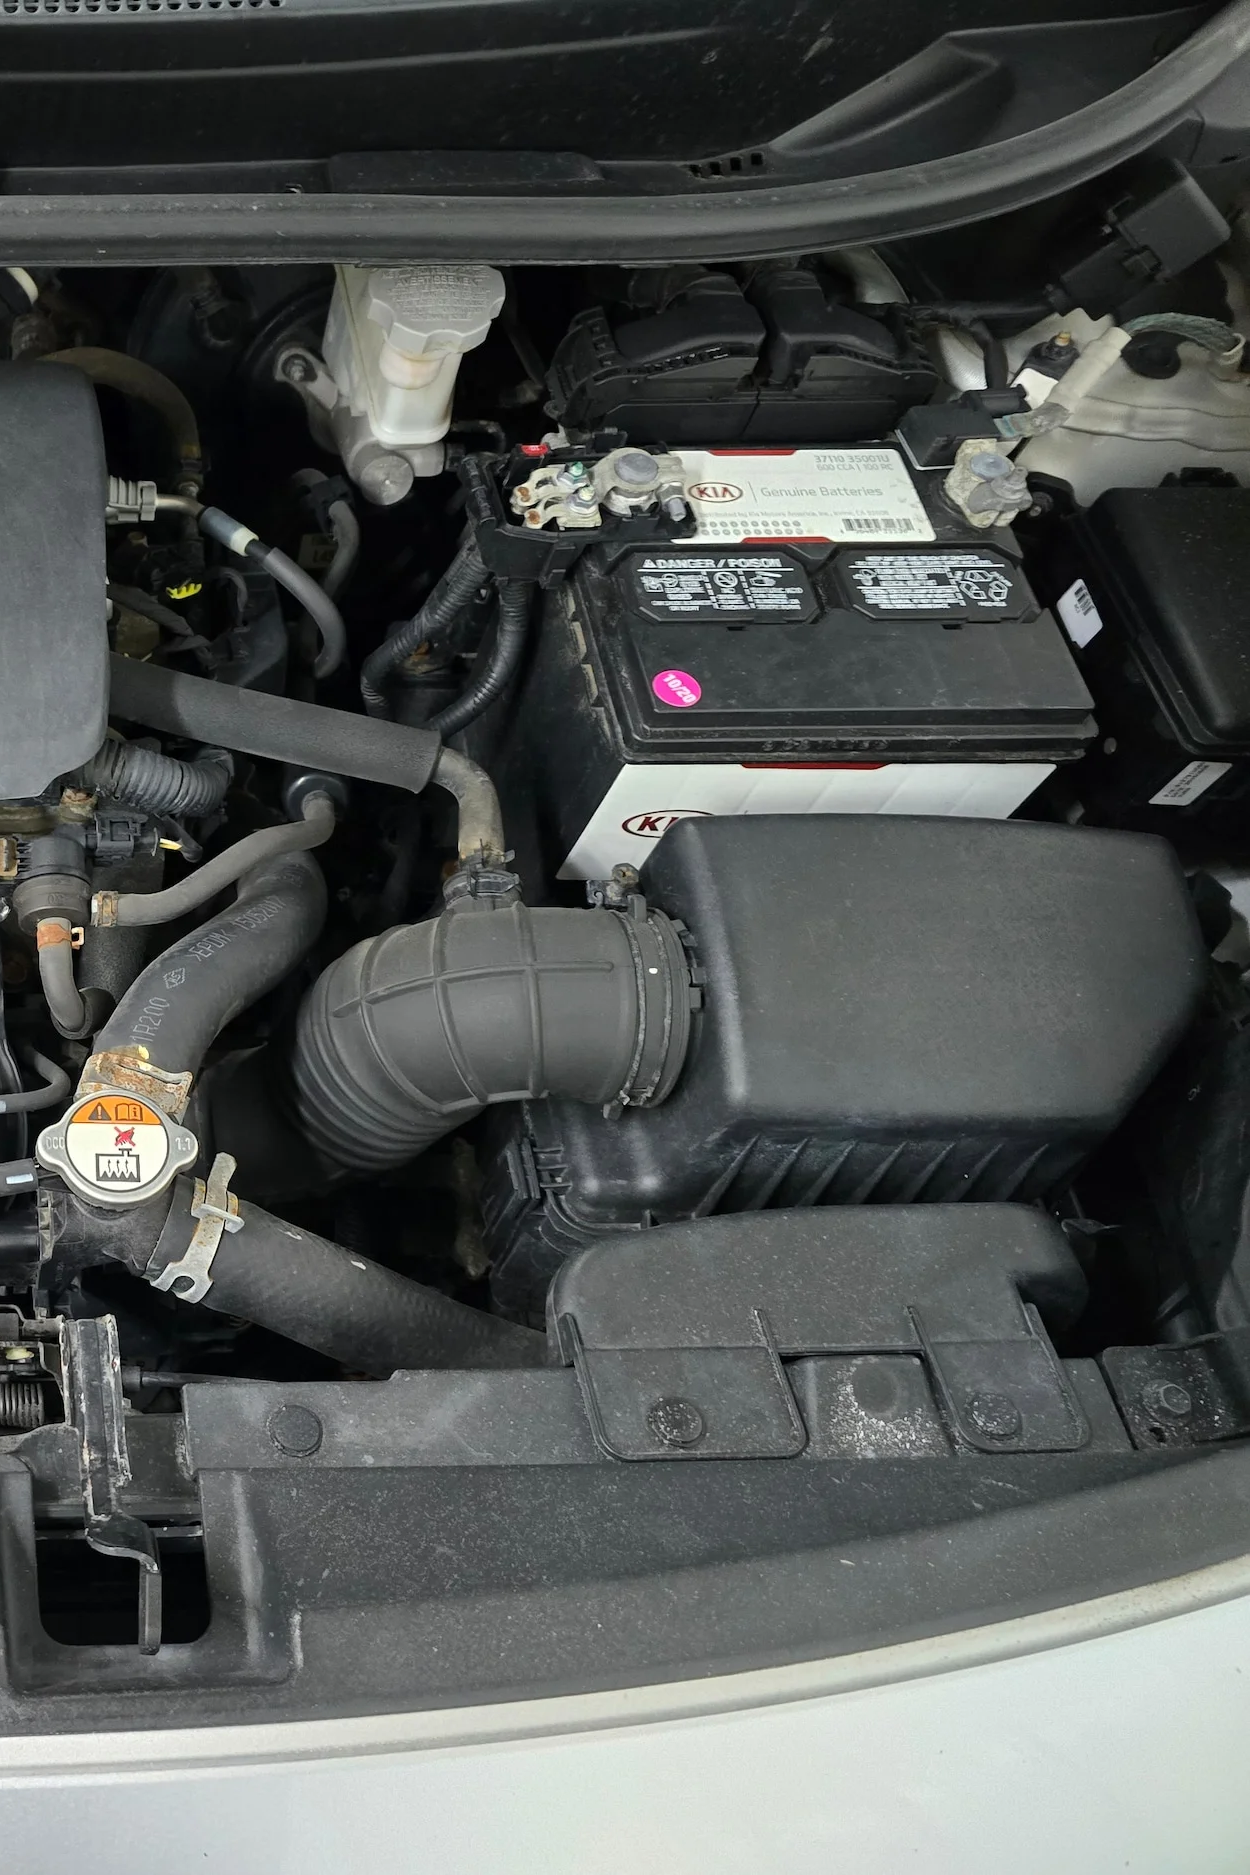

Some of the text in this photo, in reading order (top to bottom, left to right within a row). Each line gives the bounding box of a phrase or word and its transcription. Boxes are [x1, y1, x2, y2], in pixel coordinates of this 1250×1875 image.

[814, 454, 890, 463] 37110 35001U
[816, 463, 836, 471] 600
[837, 463, 856, 471] CCA
[881, 463, 894, 471] RC
[695, 486, 735, 498] KIA
[760, 485, 884, 498] Genuine Batteries
[655, 558, 715, 569] DANGER
[727, 557, 783, 568] POISON
[662, 672, 698, 704] 10/20
